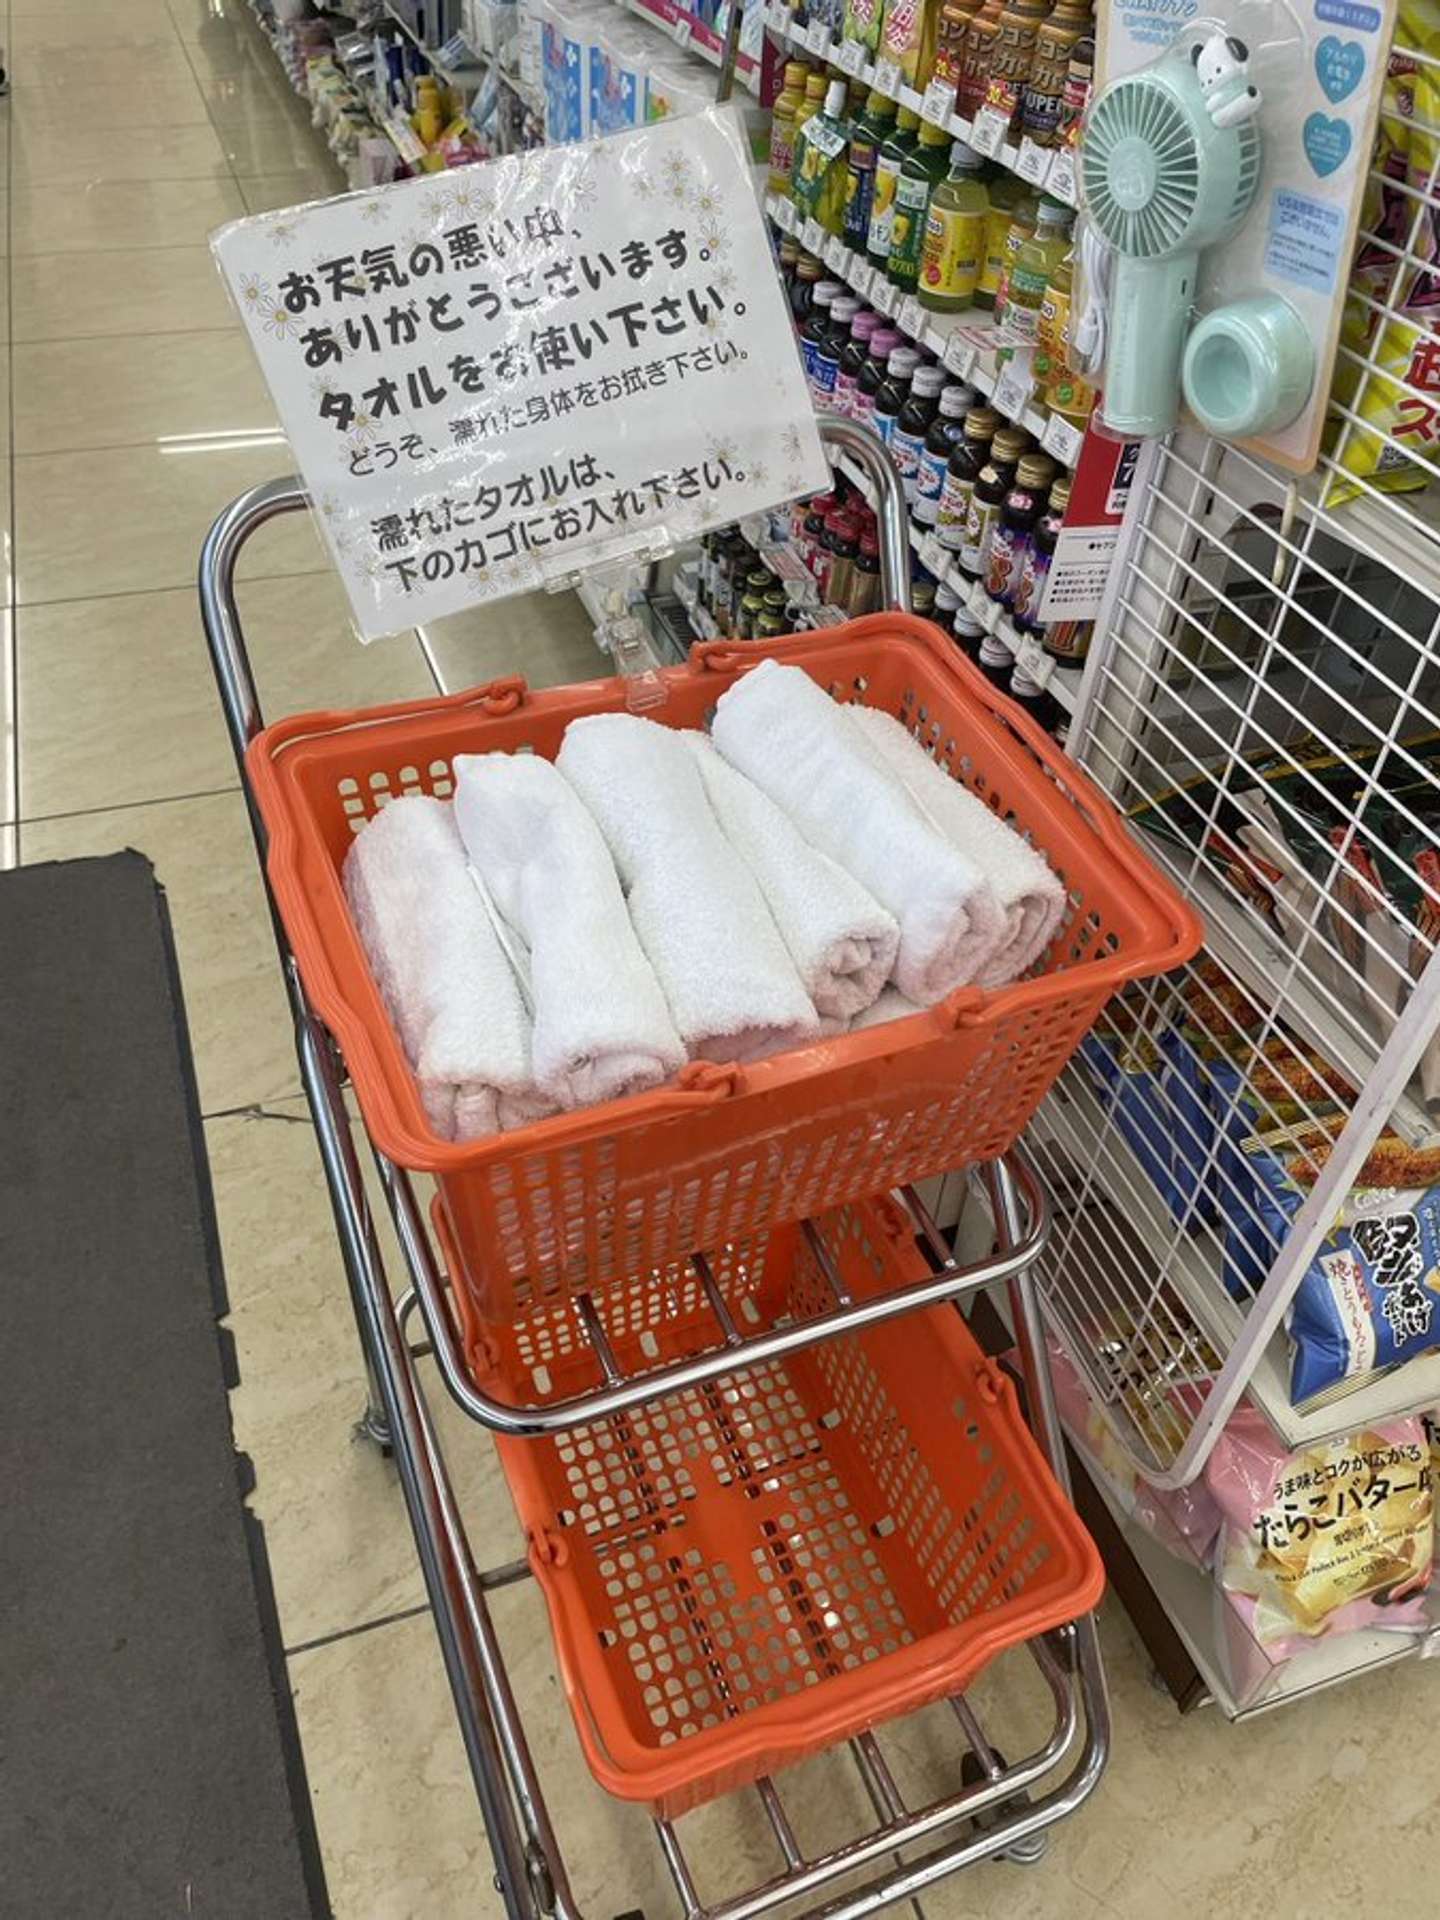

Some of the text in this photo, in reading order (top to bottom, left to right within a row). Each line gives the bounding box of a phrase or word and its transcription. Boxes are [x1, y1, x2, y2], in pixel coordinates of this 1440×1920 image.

[300, 228, 714, 369] ありがとうございます。
[319, 283, 747, 431] タオルをお使い下さい。
[371, 453, 616, 551] 濡れたタオルは、
[384, 455, 747, 592] 下のカゴにお入れ下さい。
[1274, 1445, 1421, 1499] うま味とコクが広がる
